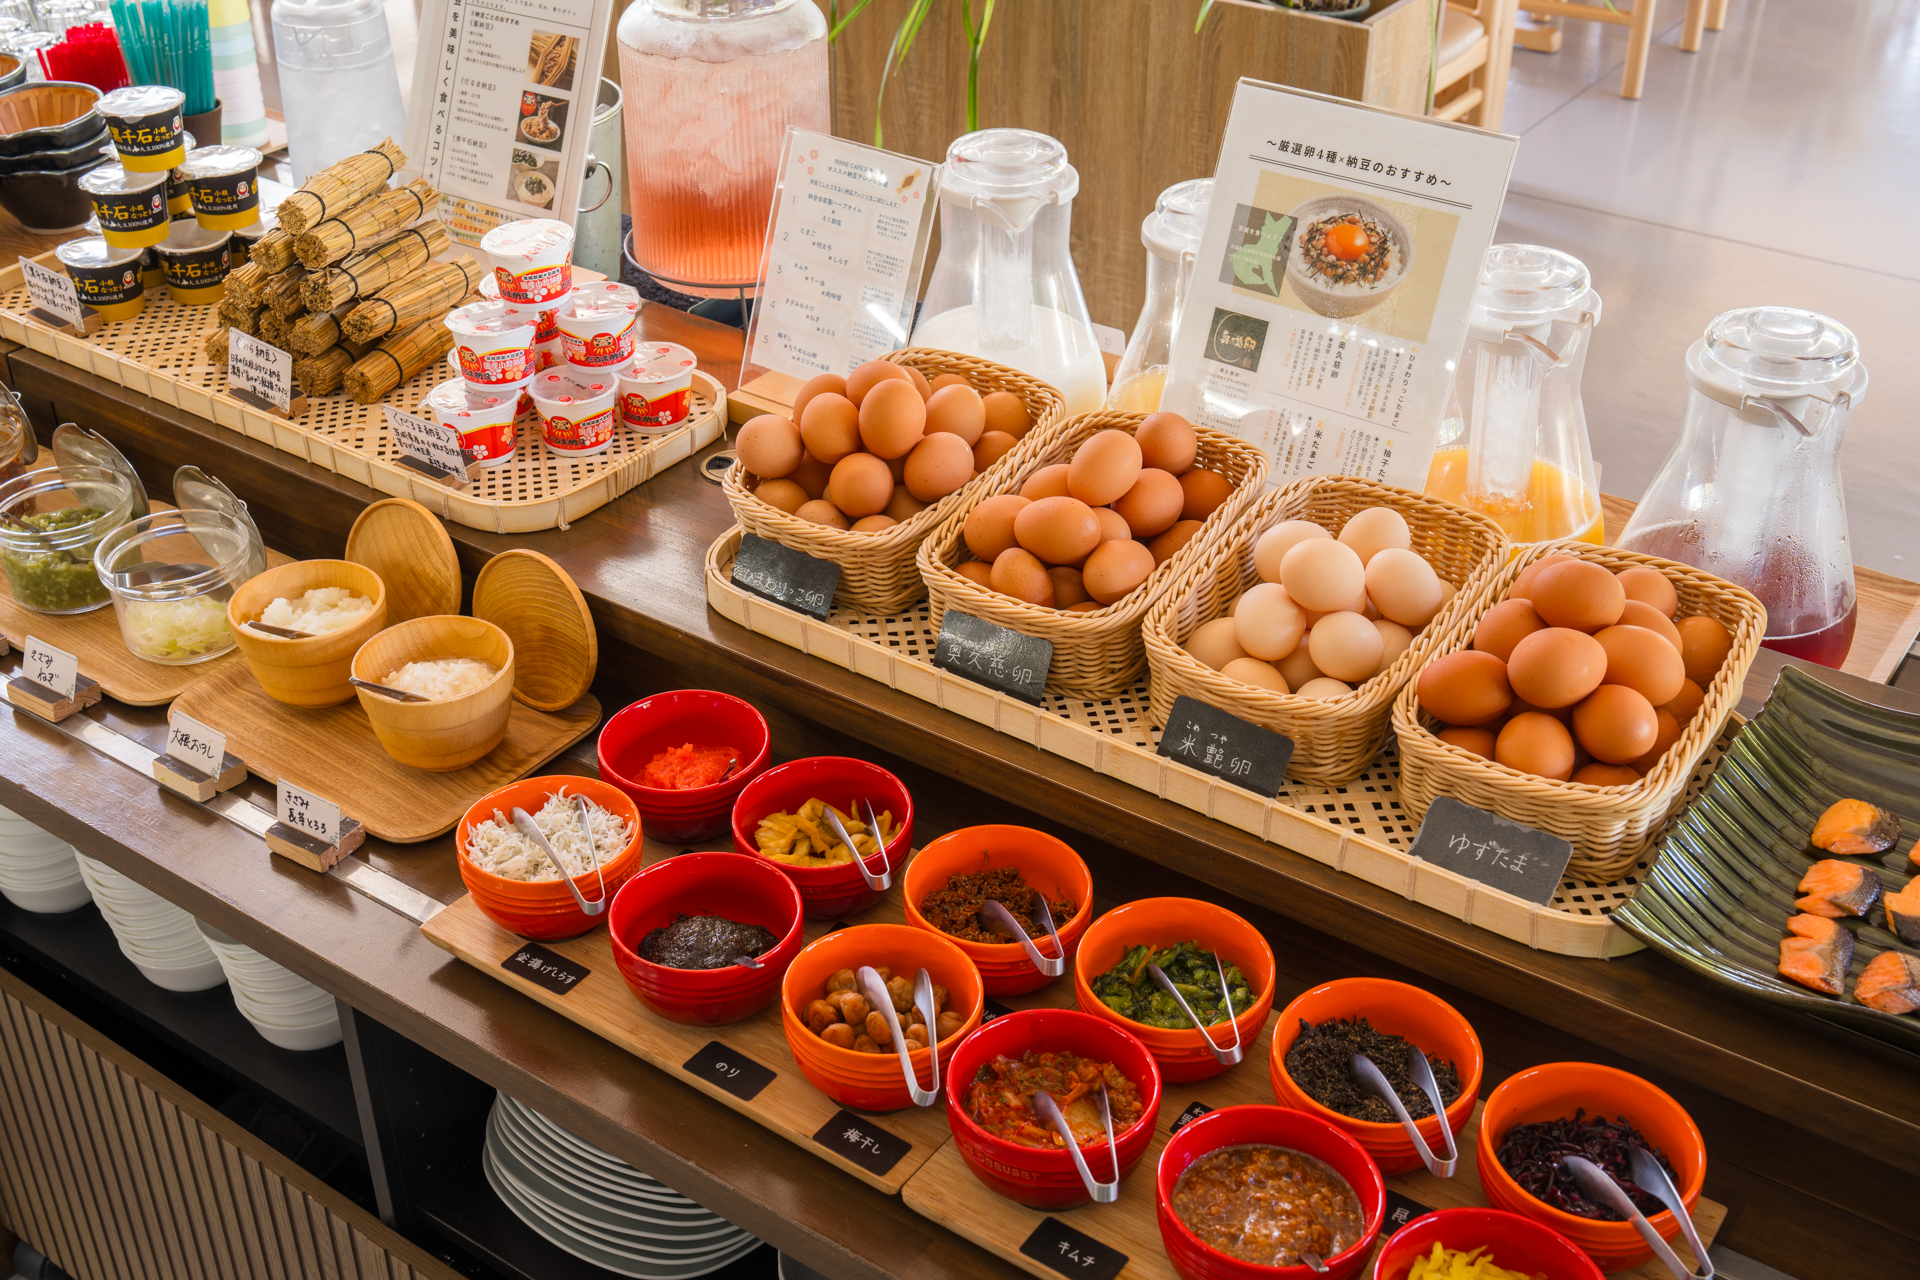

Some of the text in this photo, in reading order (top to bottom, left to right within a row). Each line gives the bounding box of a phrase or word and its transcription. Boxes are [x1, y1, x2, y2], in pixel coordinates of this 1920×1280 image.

[791, 195, 796, 204] 1
[782, 231, 789, 241] 2
[799, 227, 816, 237] たまご
[776, 264, 783, 274] 3
[792, 262, 809, 272] キムチ
[768, 299, 776, 309] 4
[784, 297, 815, 311] きざみわさび
[762, 334, 769, 344] 5
[776, 332, 792, 341] 梅干し
[586, 350, 625, 363] だるま納豆
[1329, 340, 1347, 379] 奥久慈卵
[1304, 429, 1323, 469] 米たまご
[31, 649, 54, 669] きざみ
[947, 644, 1032, 685] 奥久慈卵
[37, 667, 60, 687] ねぎ
[1186, 720, 1228, 744] こめ つや
[172, 728, 215, 759] 大根おろし
[284, 790, 309, 809] きざみ
[288, 808, 327, 834] 長芋とろろ
[1448, 832, 1528, 875] ゆずたま
[515, 951, 577, 986] 釜揚げしらす
[715, 1060, 741, 1079] のり
[842, 1127, 882, 1155] 梅干し
[977, 1153, 1040, 1181] CREUSET
[1057, 1239, 1096, 1268] キムチ
